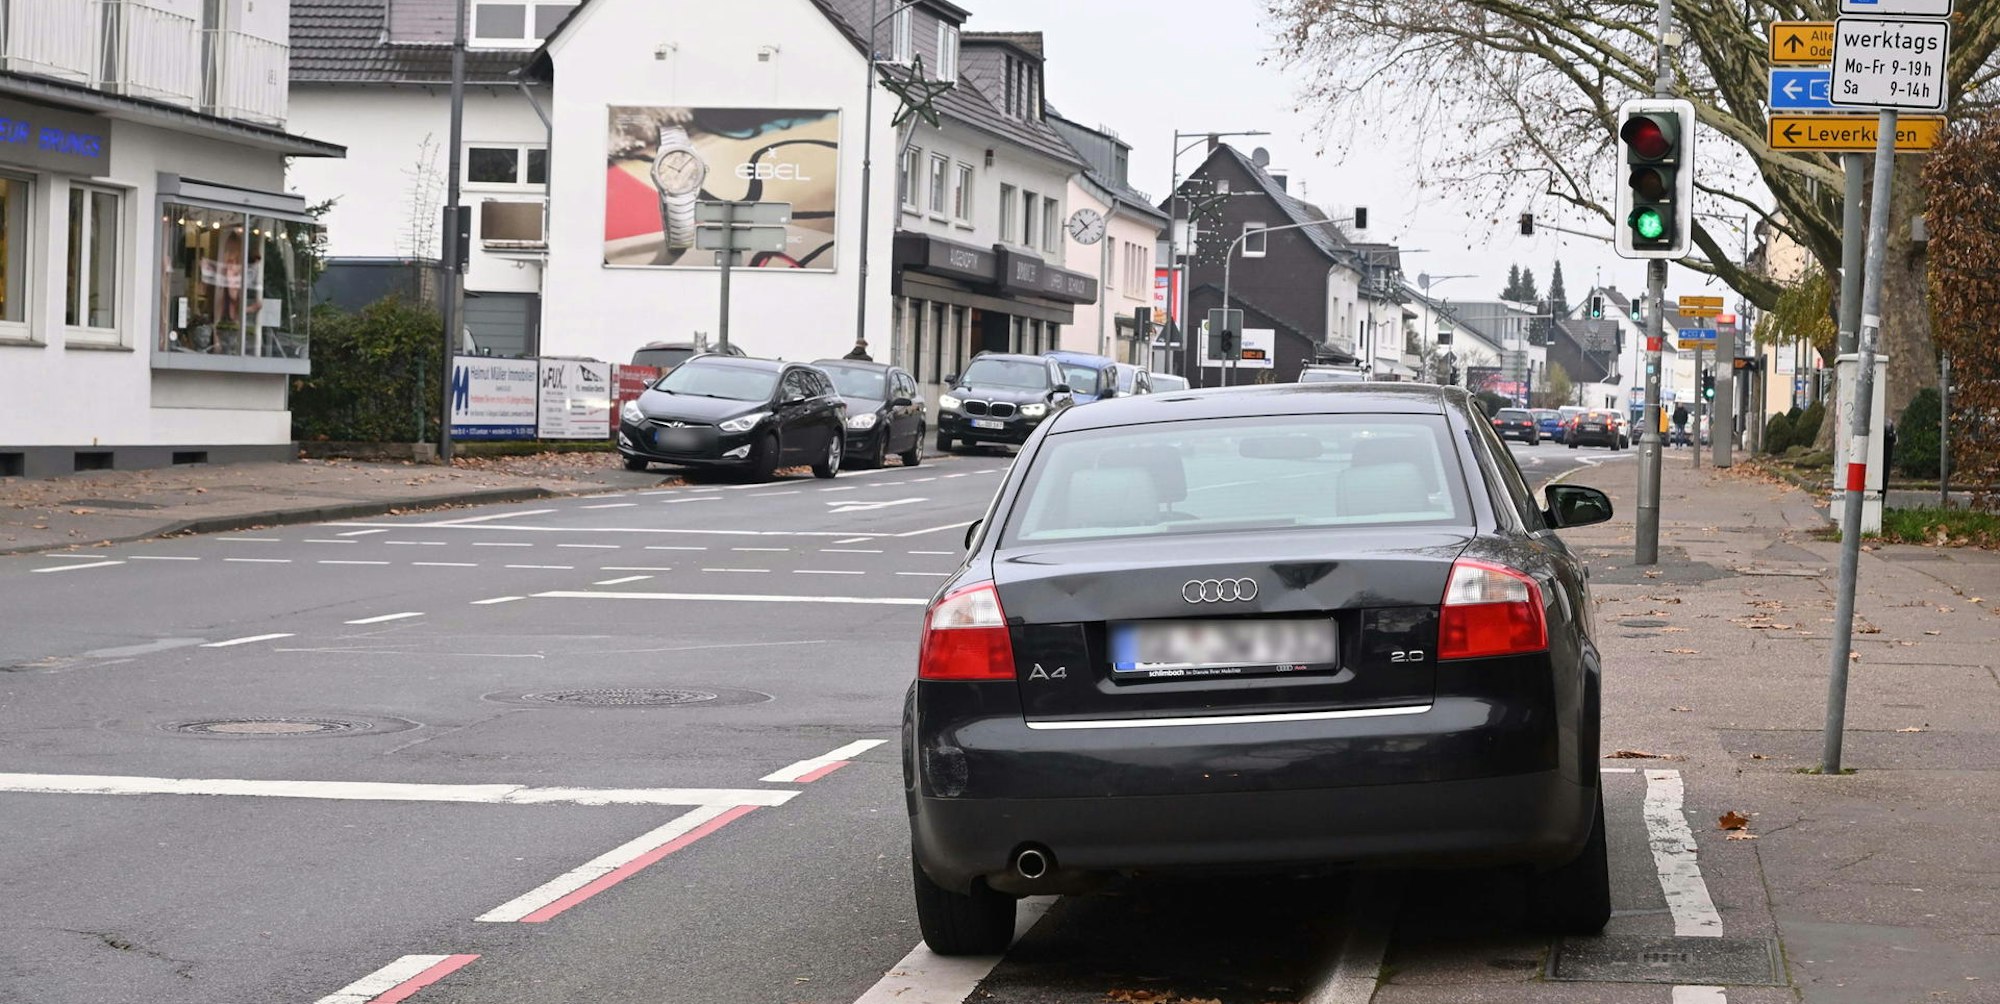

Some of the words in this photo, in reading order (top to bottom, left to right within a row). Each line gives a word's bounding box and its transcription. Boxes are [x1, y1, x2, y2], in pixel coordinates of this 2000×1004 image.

[1844, 30, 1938, 54] werktags
[1845, 58, 1886, 75] Mo-Fr
[1843, 80, 1859, 95] Sa
[39, 127, 102, 158] BRUNGS
[1808, 125, 1917, 143] Leverkuen
[735, 162, 811, 181] EBEL
[490, 365, 507, 381] Müller
[1391, 650, 1424, 662] 2.0
[1028, 663, 1067, 681] A4
